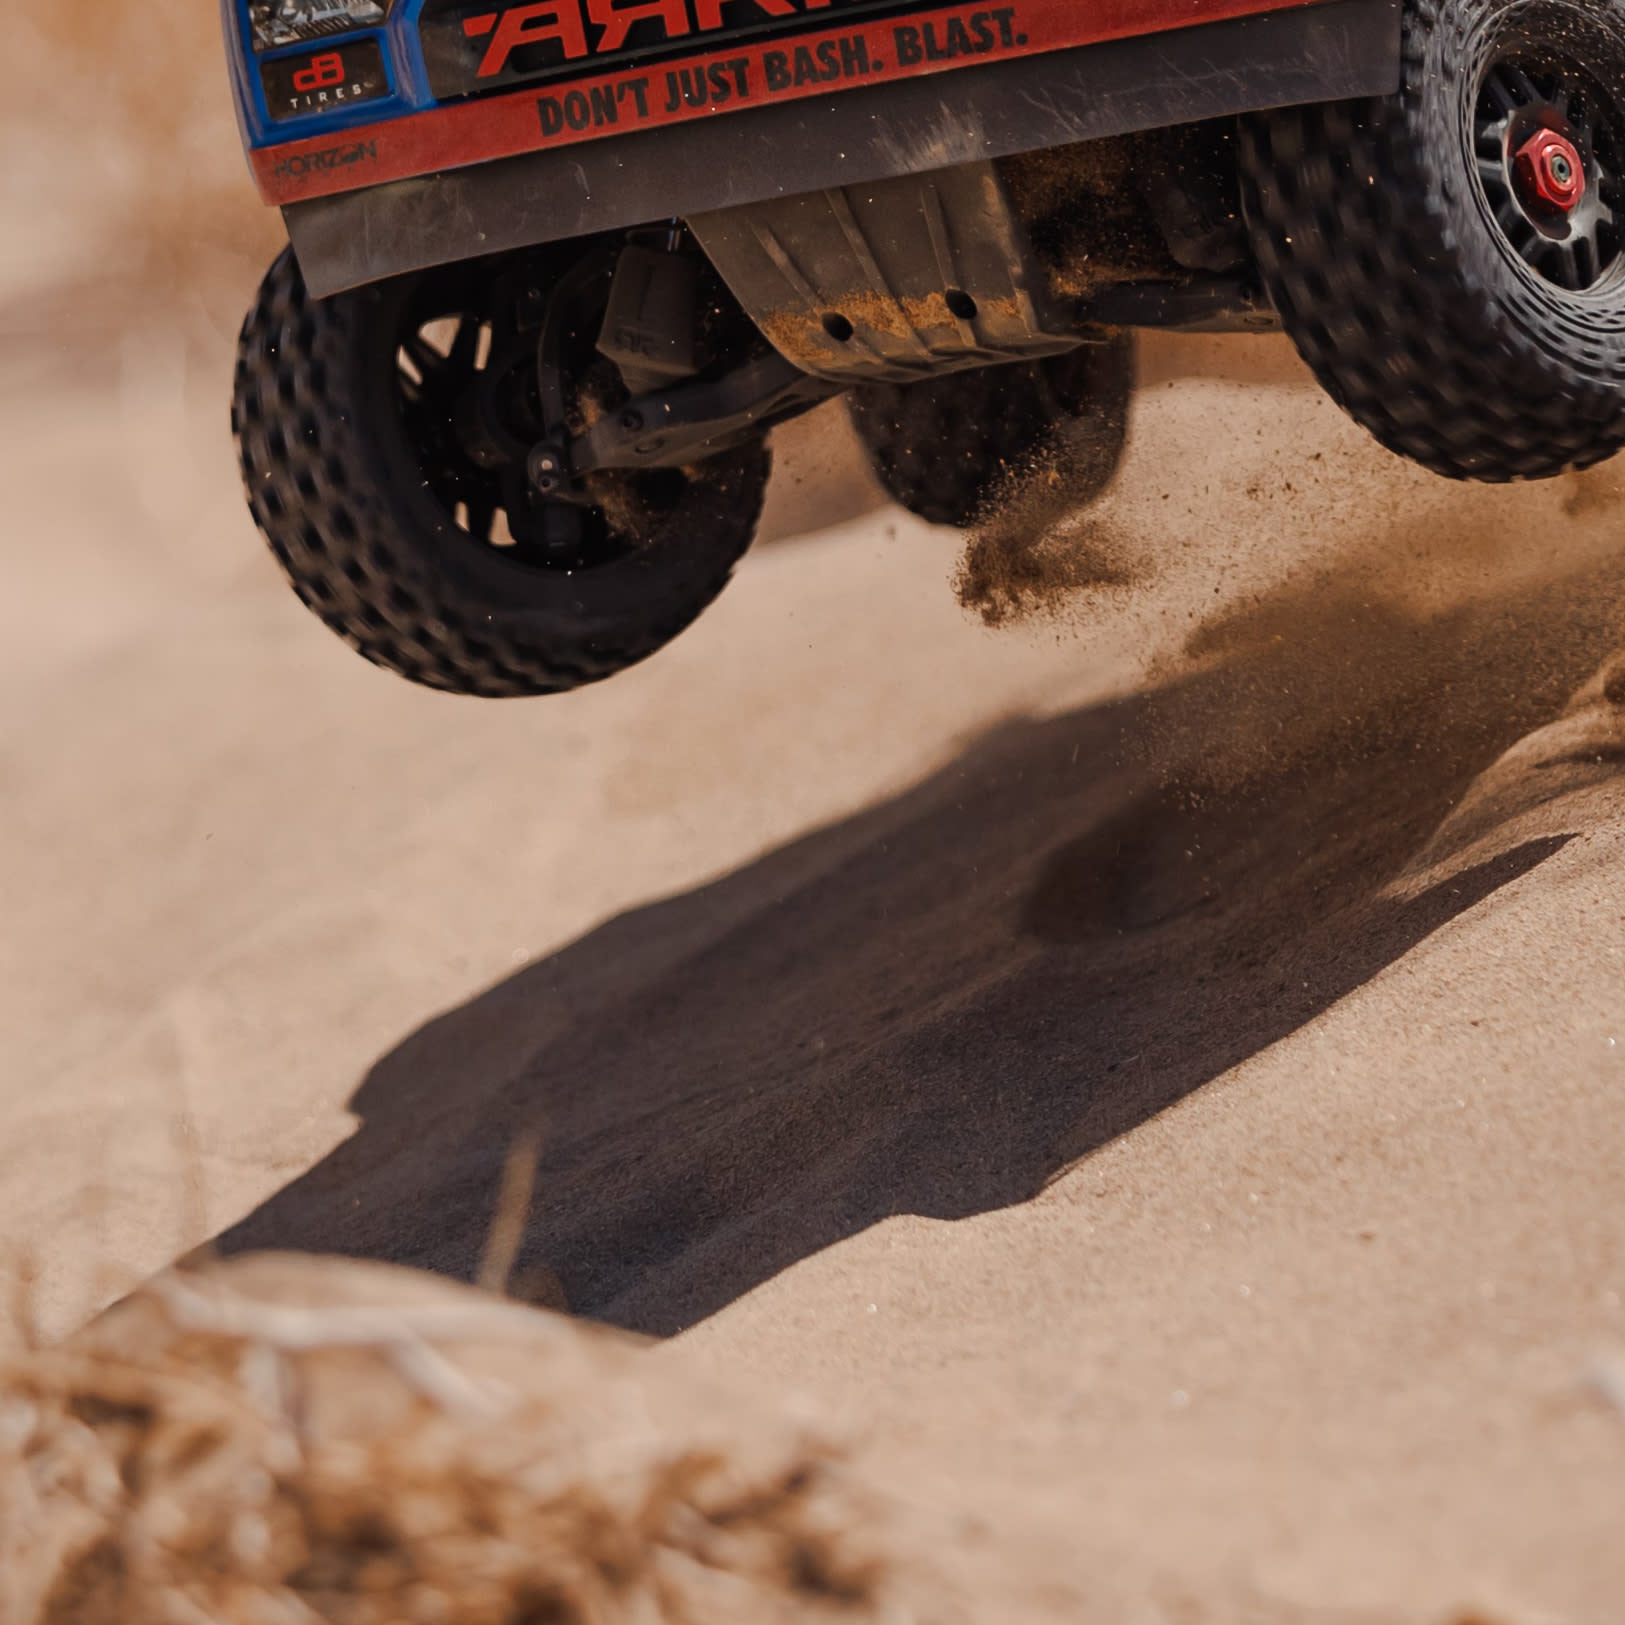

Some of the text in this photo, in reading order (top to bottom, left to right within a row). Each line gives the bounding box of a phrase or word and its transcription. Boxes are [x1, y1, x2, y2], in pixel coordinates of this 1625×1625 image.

[536, 6, 1029, 137] DON'T JUST BASH. BLAST.
[290, 84, 362, 109] TIRES
[273, 138, 378, 178] HORIZON
